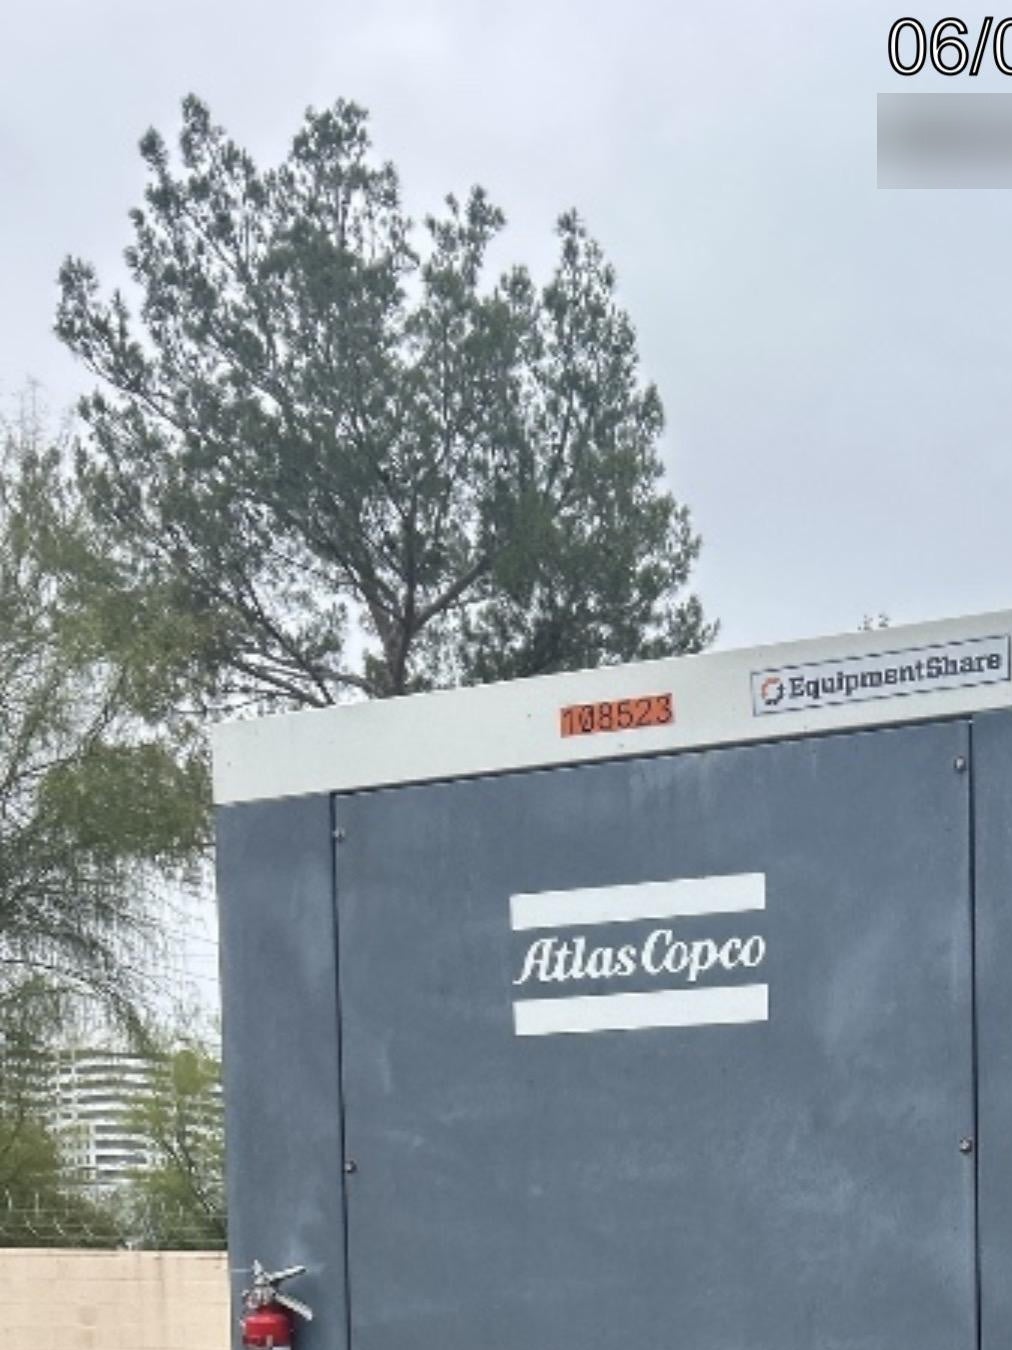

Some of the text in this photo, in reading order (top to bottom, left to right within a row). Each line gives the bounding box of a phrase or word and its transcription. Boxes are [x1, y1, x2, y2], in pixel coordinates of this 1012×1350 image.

[788, 653, 1002, 701] EquipmentShare
[563, 694, 673, 735] 108523
[512, 929, 766, 985] Atlas Copco
